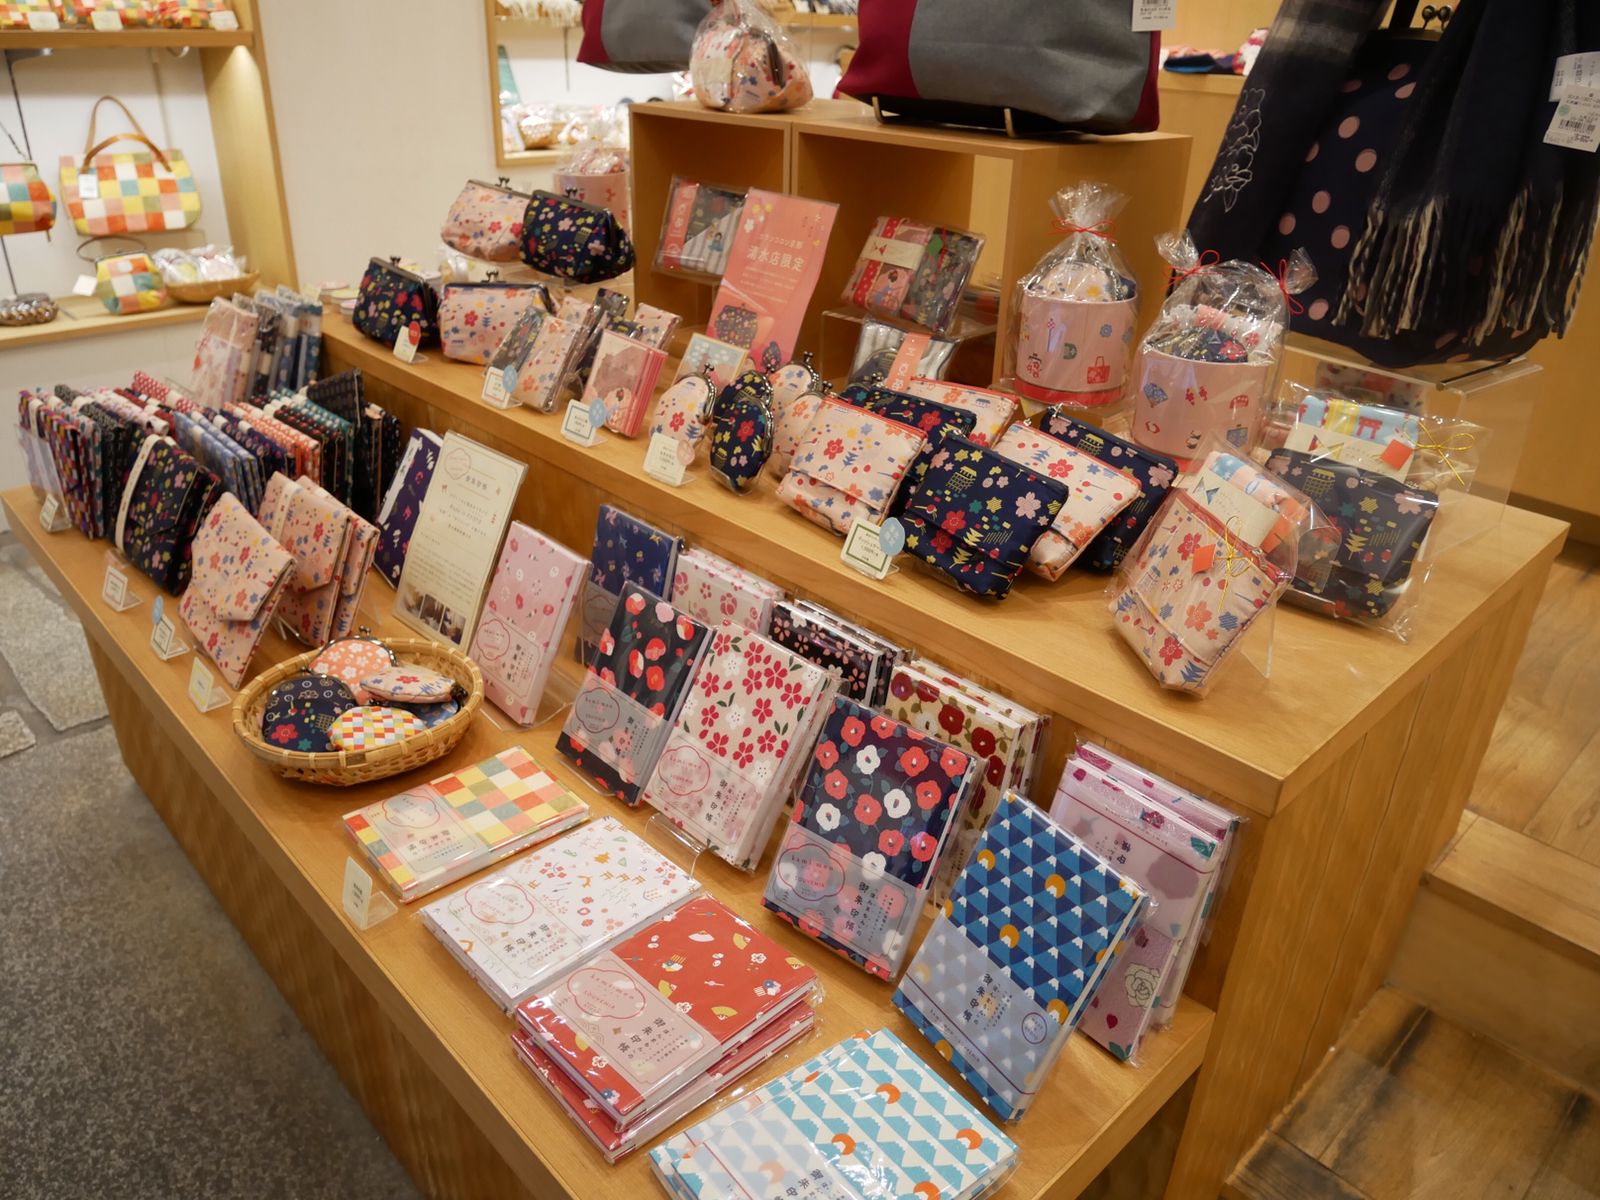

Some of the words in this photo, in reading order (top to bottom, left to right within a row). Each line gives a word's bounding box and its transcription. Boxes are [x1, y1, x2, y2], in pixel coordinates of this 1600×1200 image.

[747, 246, 804, 272] 清水店限定
[705, 778, 728, 823] 御朱印帳
[845, 881, 870, 932] 御朱印帳
[963, 973, 994, 1023] 御朱印帳
[617, 1016, 667, 1053] 御朱印帳
